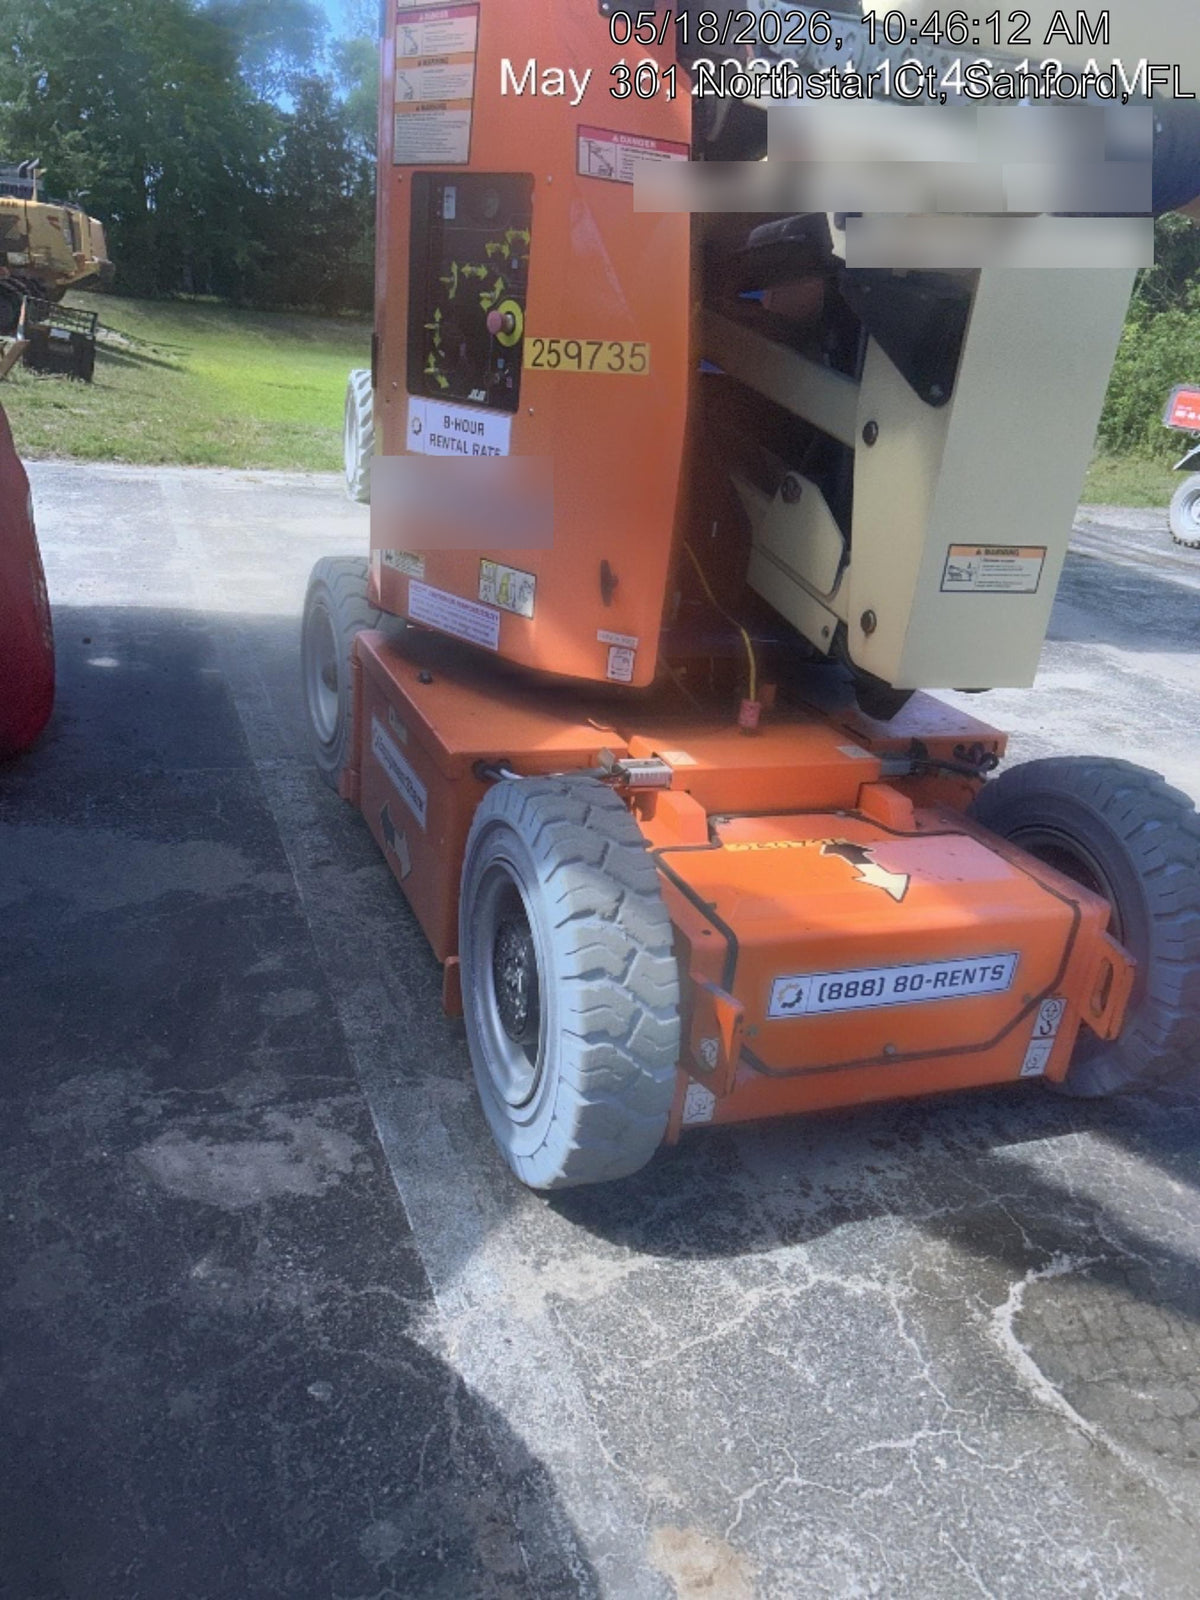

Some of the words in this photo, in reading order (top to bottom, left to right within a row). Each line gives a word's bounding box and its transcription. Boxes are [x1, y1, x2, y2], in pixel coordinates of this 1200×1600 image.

[532, 339, 646, 372] 259735
[429, 433, 469, 454] RENTAL
[818, 976, 886, 1003] (888)
[893, 964, 1005, 993] 80-RENTS
